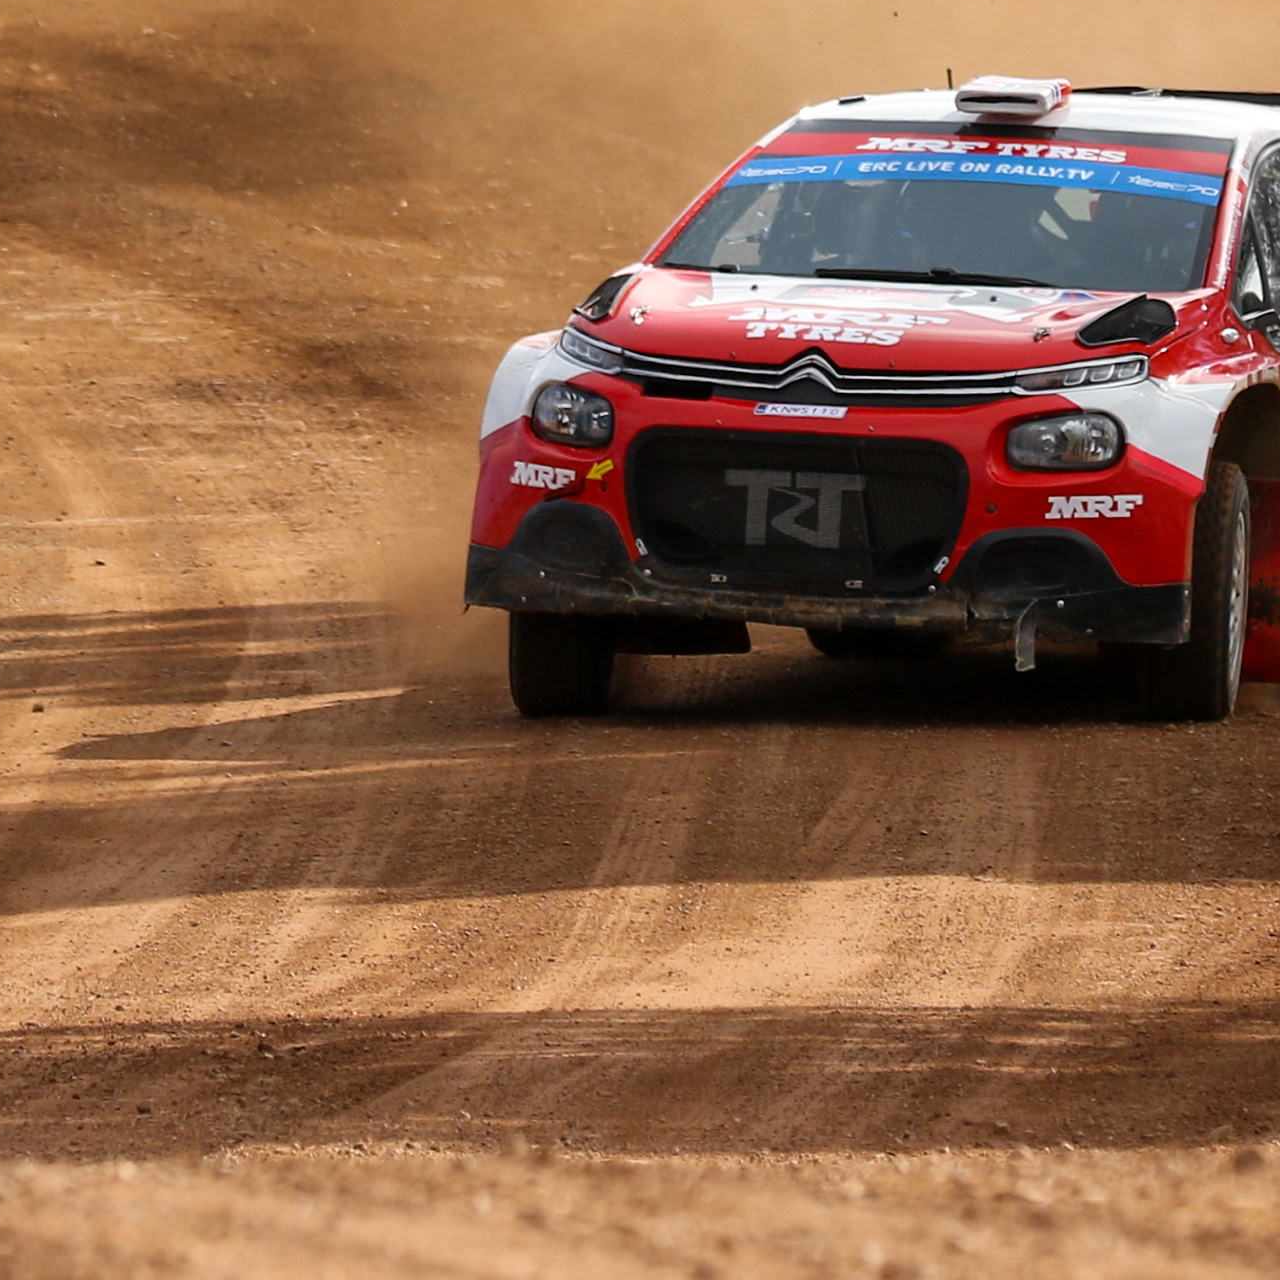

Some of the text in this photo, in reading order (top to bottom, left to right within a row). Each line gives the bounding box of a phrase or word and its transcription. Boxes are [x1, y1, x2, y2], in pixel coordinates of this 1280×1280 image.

[856, 137, 1128, 163] MRF TYRES
[858, 161, 902, 173] ERC
[905, 161, 956, 173] LIVE
[960, 162, 990, 174] ON
[995, 163, 1095, 181] RALLY.TV
[729, 307, 950, 330] MRF
[745, 322, 905, 346] TYRES
[510, 460, 576, 490] MRF
[1045, 494, 1143, 519] MRF
